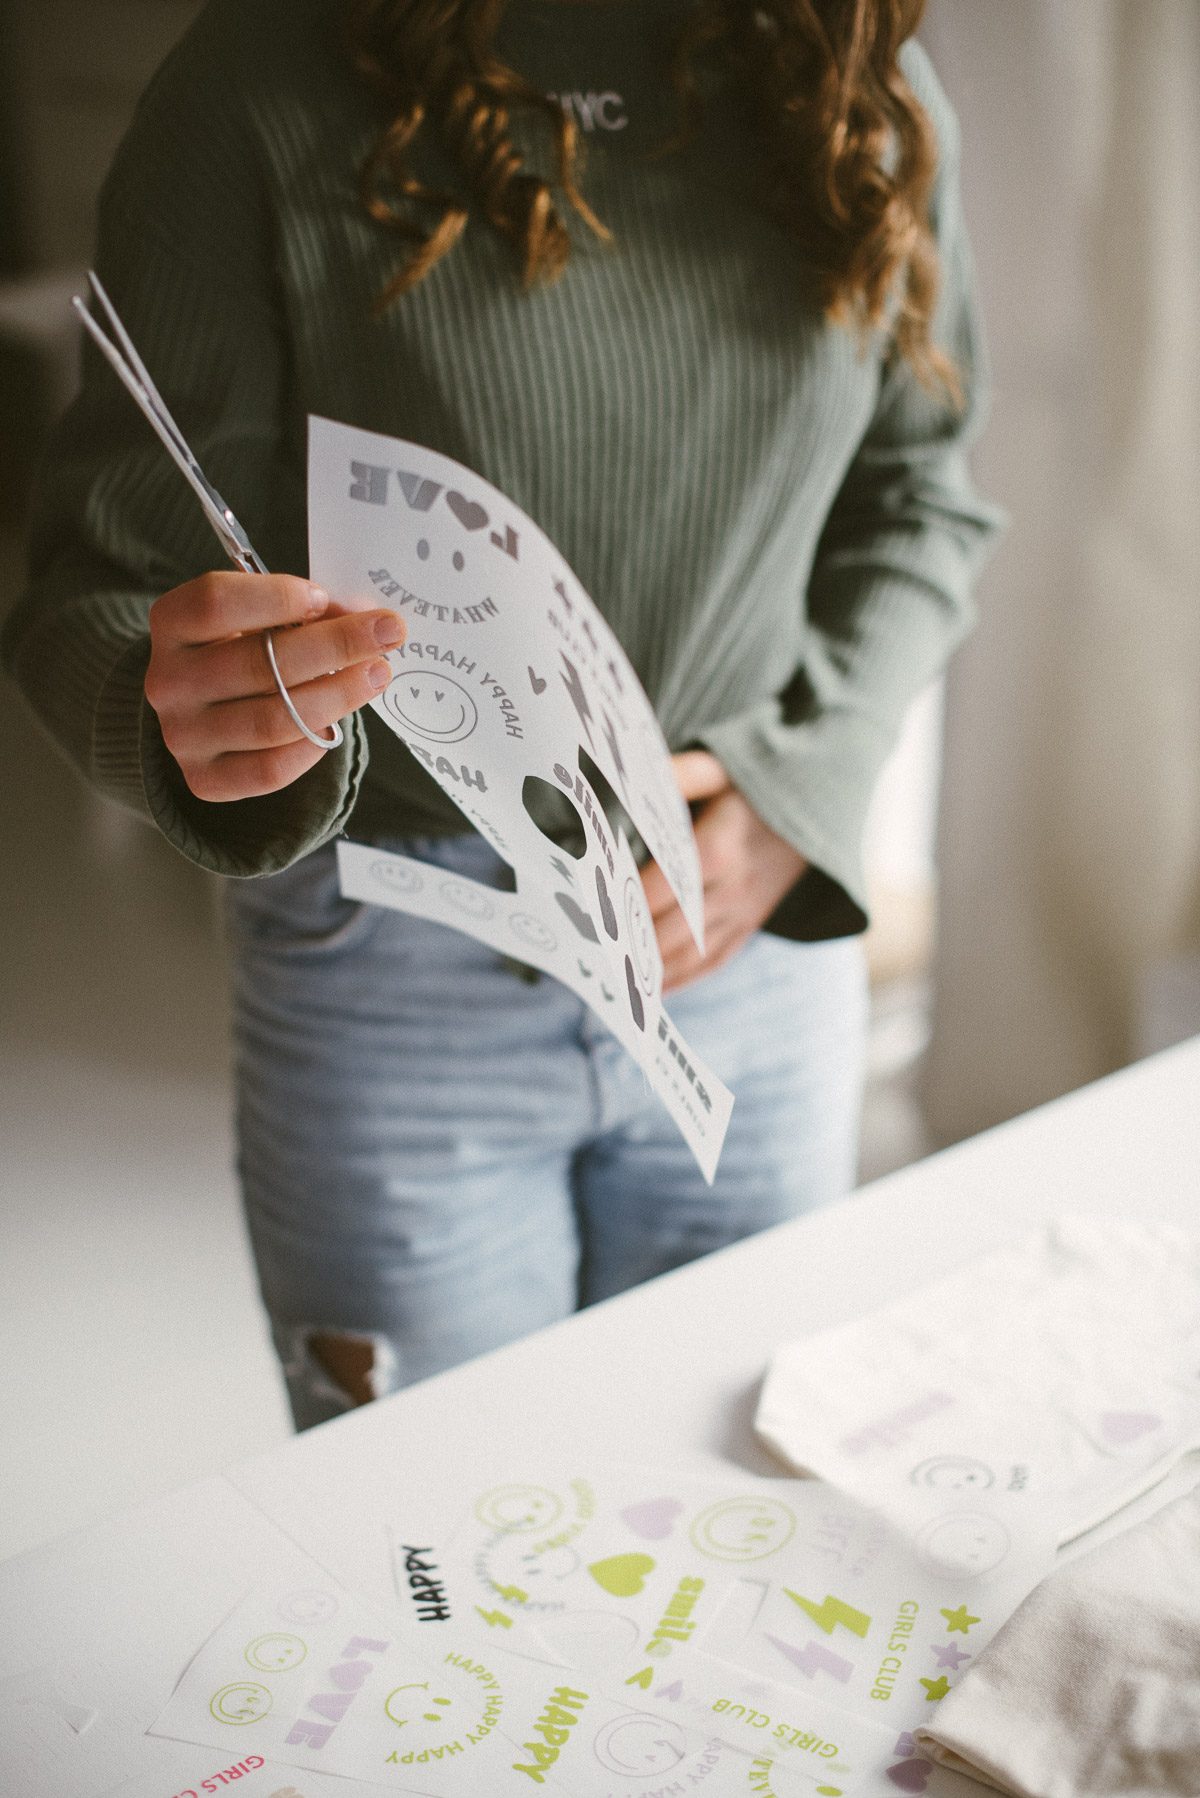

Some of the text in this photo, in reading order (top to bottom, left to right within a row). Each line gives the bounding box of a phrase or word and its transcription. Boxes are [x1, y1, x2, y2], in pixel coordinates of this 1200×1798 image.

[402, 1545, 452, 1622] HAPPY
[870, 1601, 919, 1701] GIRLS CLUB
[385, 1652, 504, 1765] HAPPY HAPPY HAPPY
[512, 1686, 589, 1783] HAPPY
[712, 1698, 839, 1758] GIRLS CLUB
[201, 1755, 265, 1793] GIRLS
